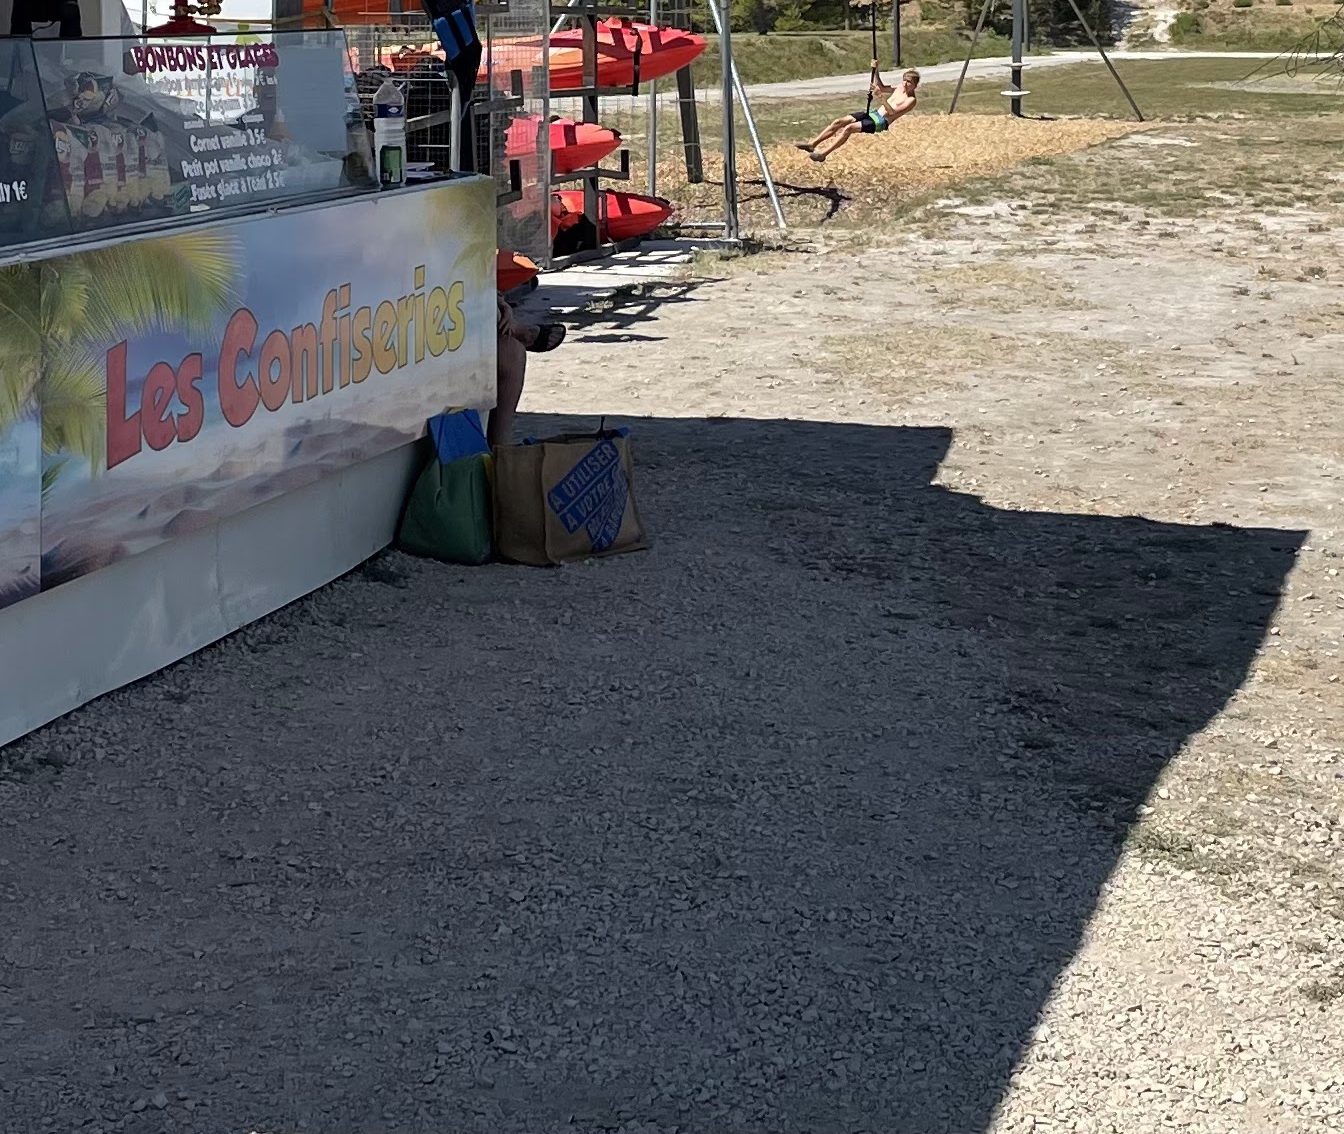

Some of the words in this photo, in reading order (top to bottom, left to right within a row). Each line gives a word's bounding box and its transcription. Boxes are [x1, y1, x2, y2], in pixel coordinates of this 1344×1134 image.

[131, 46, 206, 73] BONBONS
[208, 46, 224, 70] ET
[190, 135, 221, 152] Cornet
[220, 130, 247, 149] vanille
[181, 159, 204, 178] Petit
[204, 159, 219, 178] pot
[219, 154, 247, 172] vanille
[248, 152, 271, 168] choco
[11, 180, 28, 201] 1€
[217, 179, 240, 201] glace
[106, 339, 204, 471] Les
[218, 265, 465, 428] Confiseries
[562, 443, 616, 498] UTILISER
[576, 476, 611, 518] VOTRE
